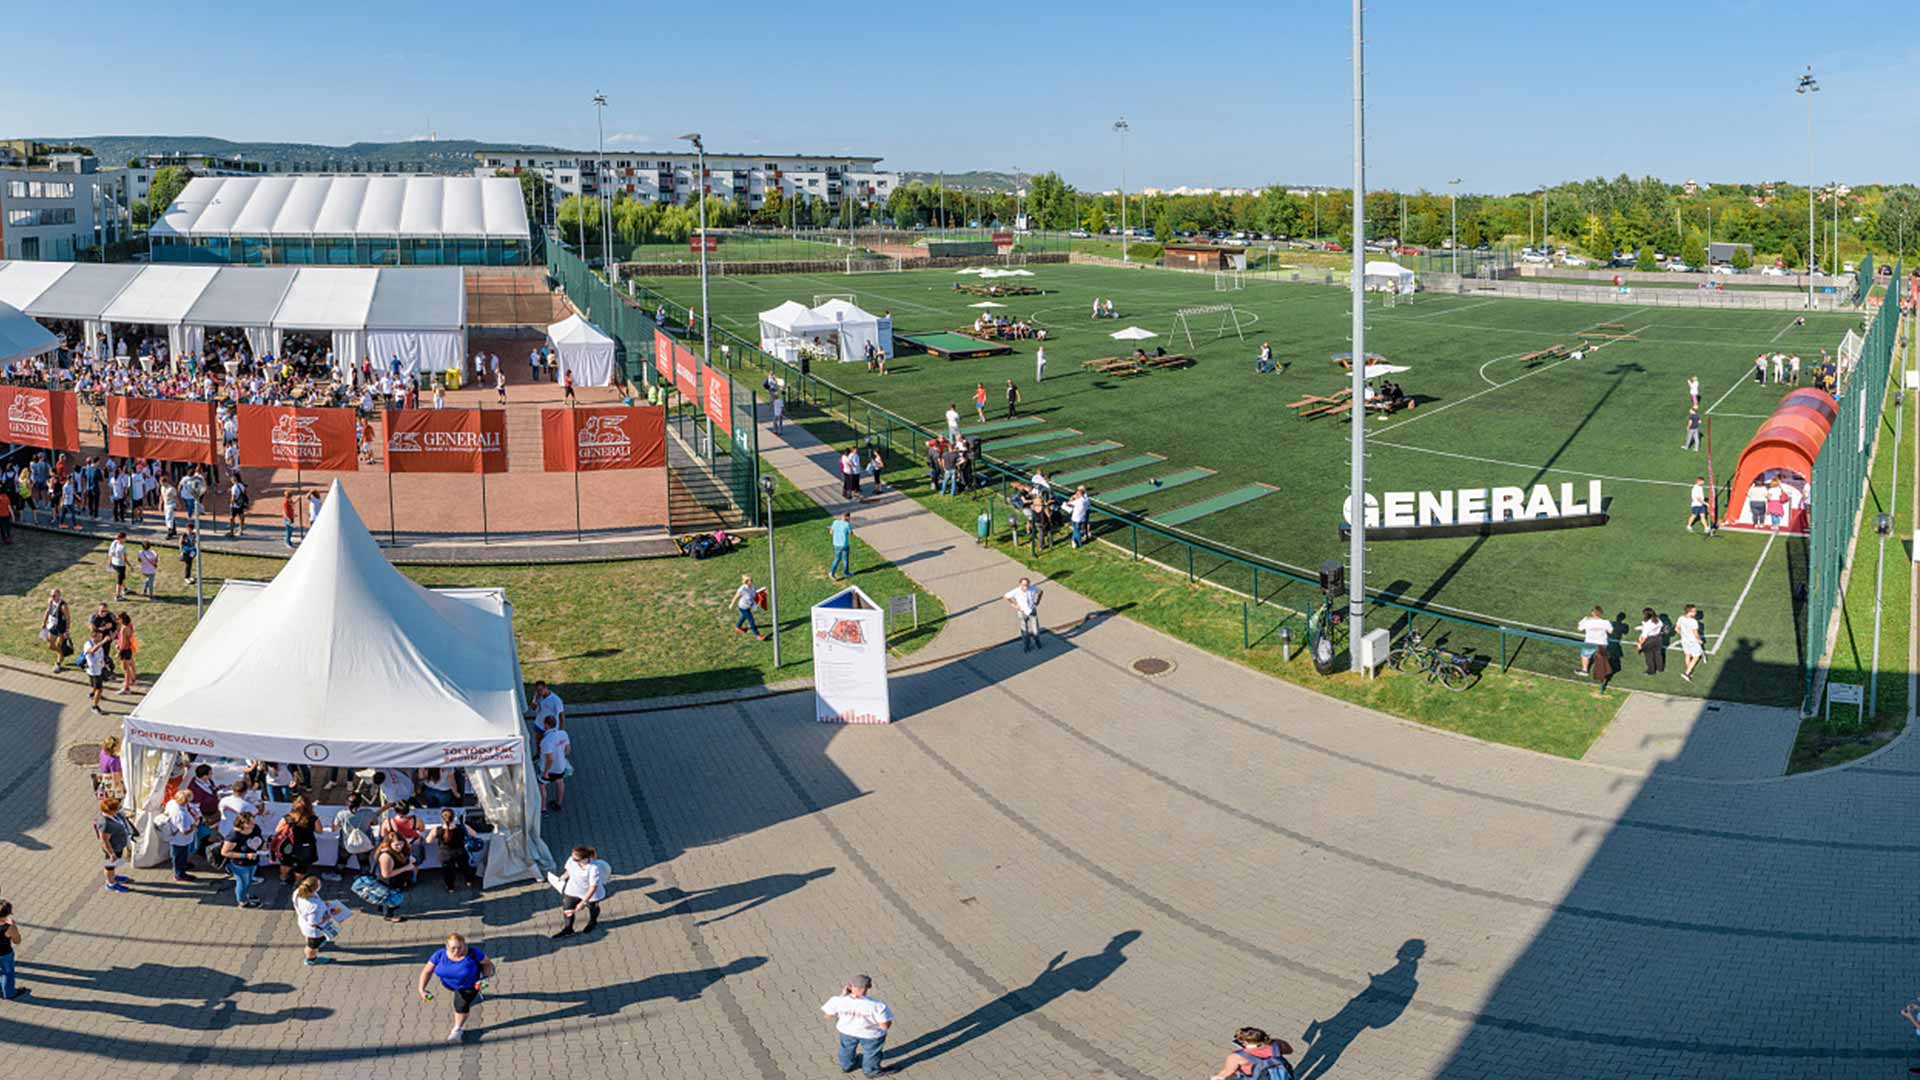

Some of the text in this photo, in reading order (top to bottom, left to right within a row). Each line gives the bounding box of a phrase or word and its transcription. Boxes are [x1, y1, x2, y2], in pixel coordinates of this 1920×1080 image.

[143, 420, 210, 437] GENERALI
[423, 431, 500, 446] GENERALI
[272, 445, 322, 457] GENERALI
[578, 446, 631, 458] GENERALI
[1343, 480, 1602, 528] GENERALI
